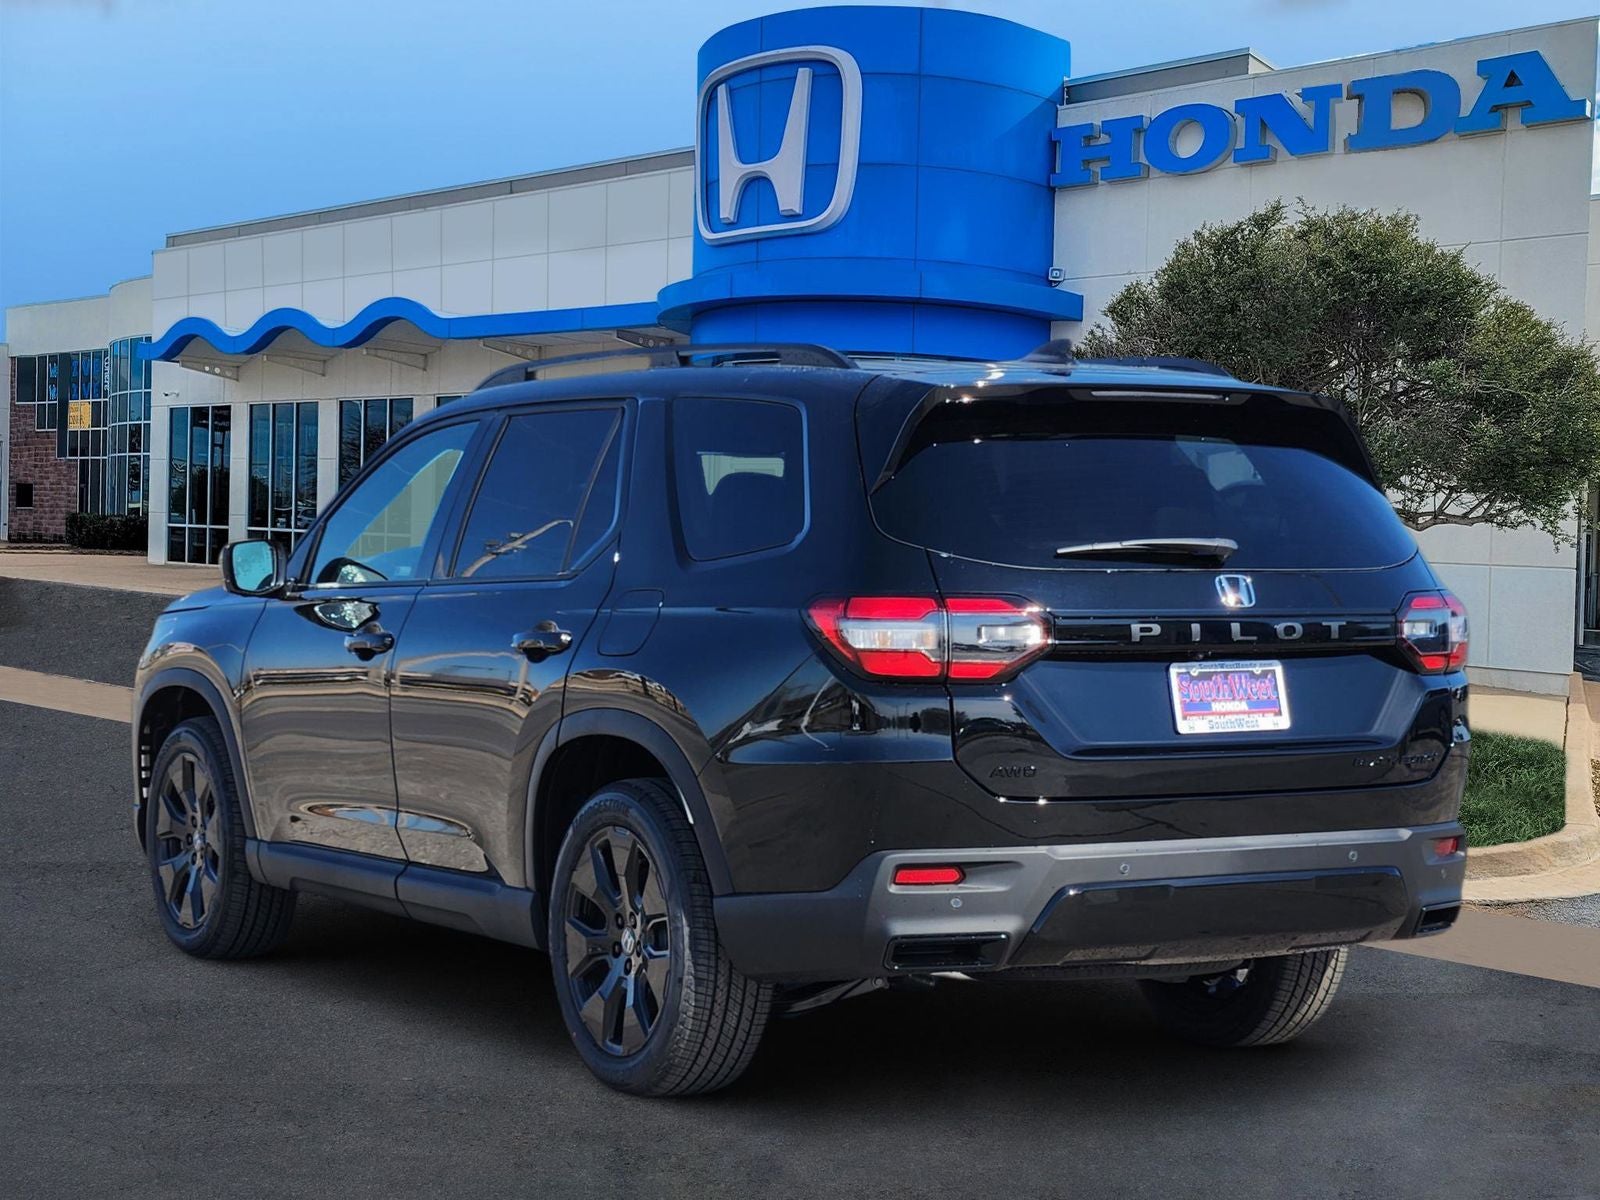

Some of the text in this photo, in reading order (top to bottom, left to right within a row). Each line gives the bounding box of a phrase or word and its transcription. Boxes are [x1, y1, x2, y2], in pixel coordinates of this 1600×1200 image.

[1051, 50, 1592, 189] HONDA
[1130, 621, 1346, 642] PILOT
[1177, 673, 1278, 702] SouthWest
[1211, 701, 1249, 712] HONDA
[1208, 718, 1260, 730] SouthWest
